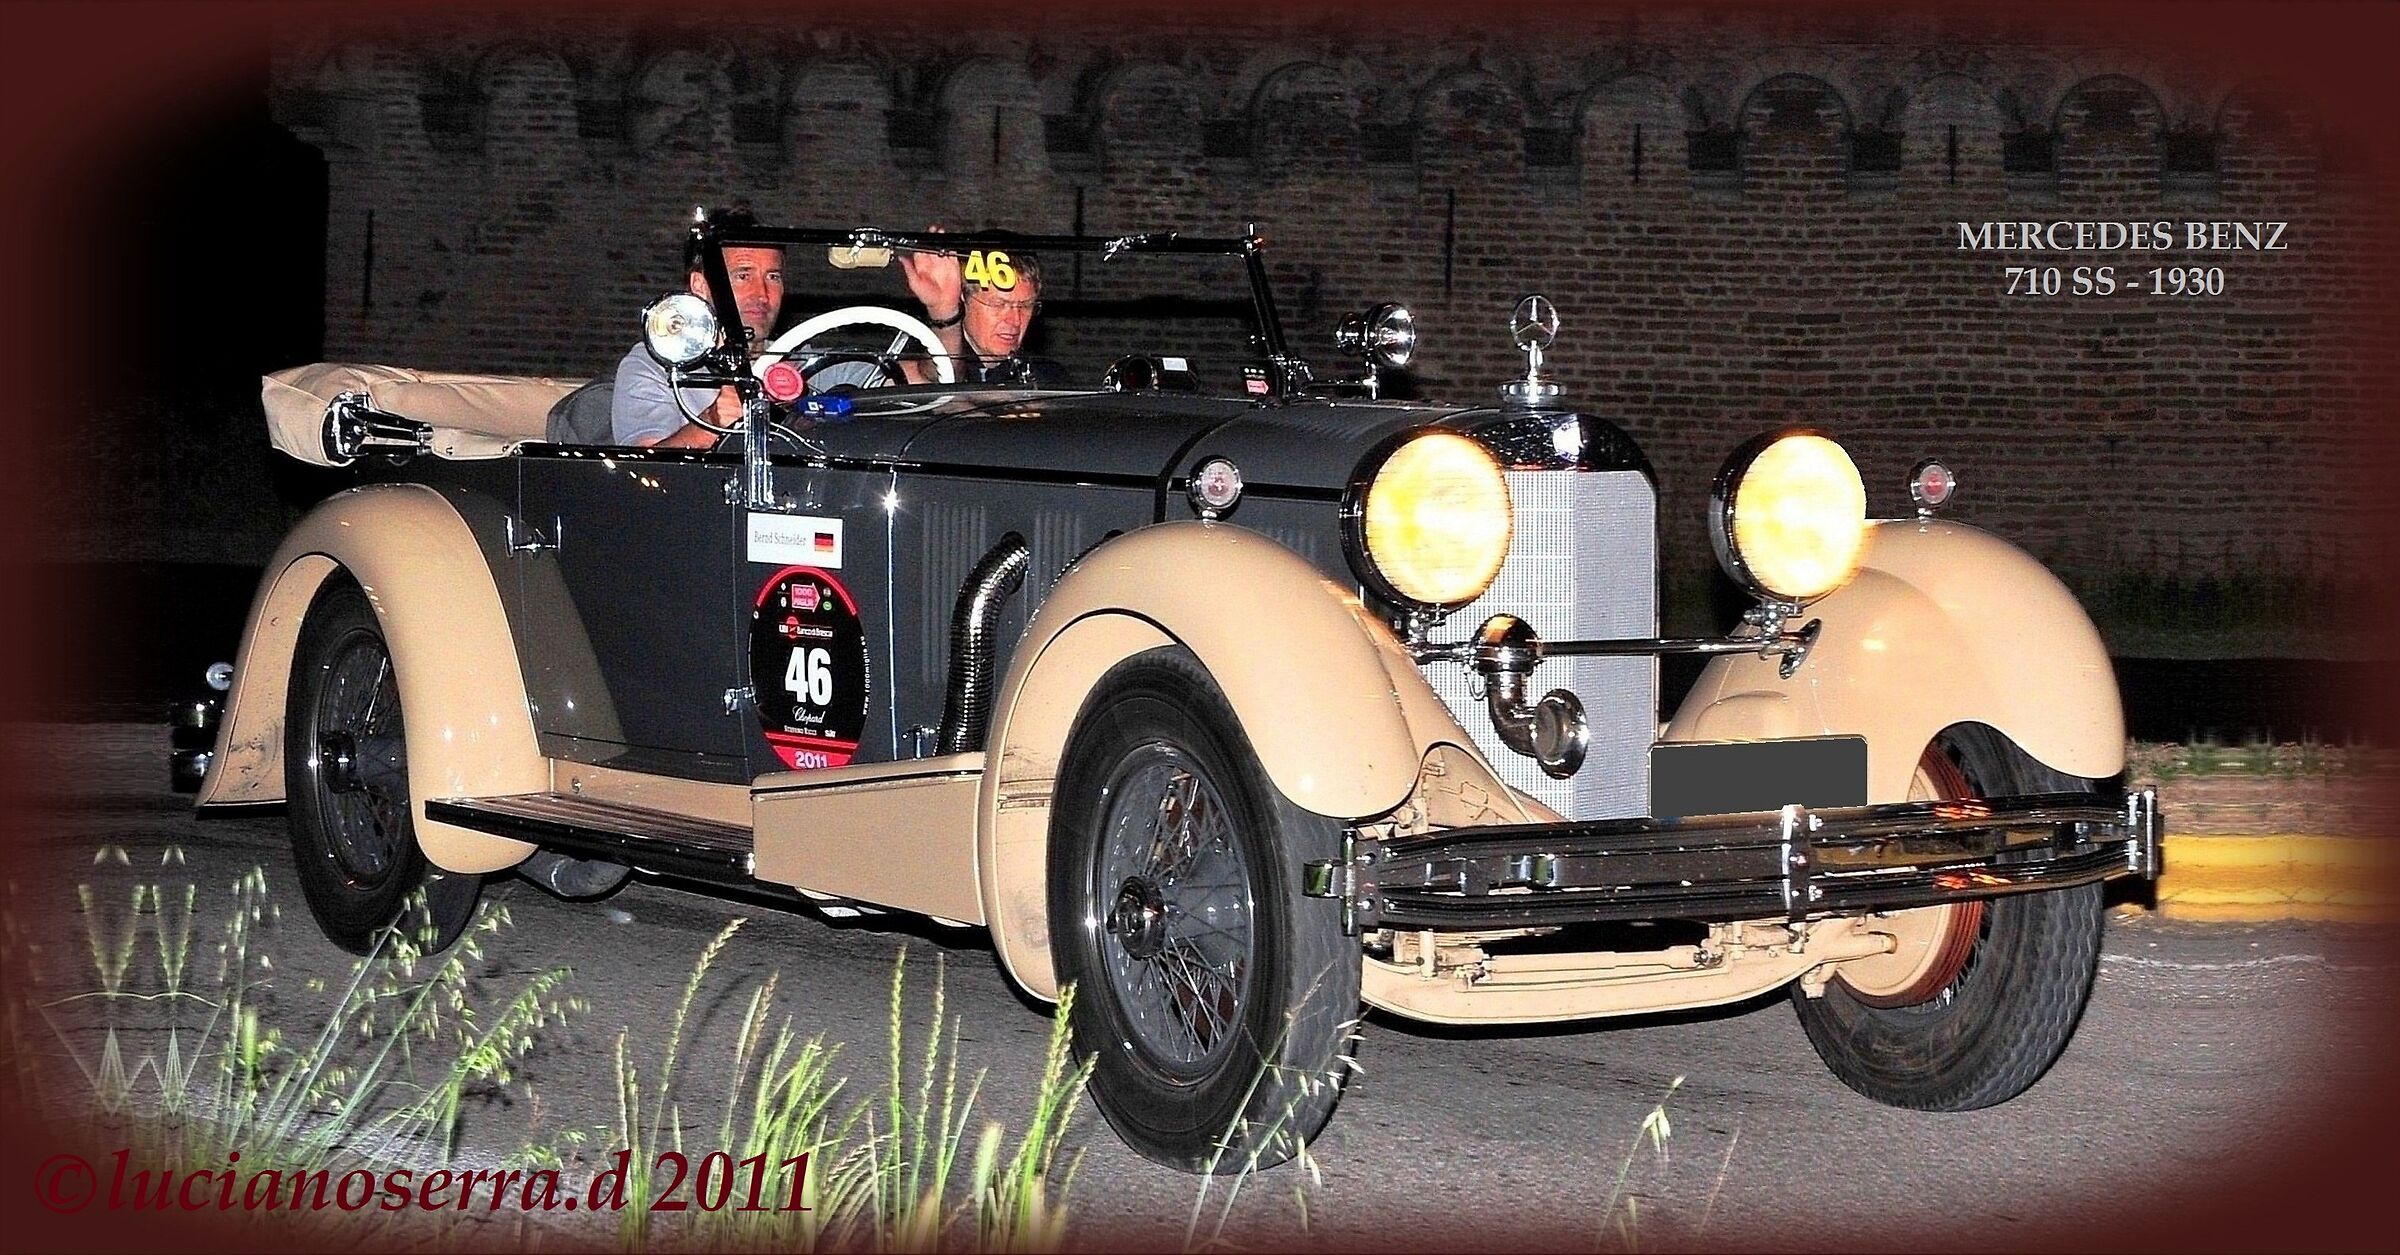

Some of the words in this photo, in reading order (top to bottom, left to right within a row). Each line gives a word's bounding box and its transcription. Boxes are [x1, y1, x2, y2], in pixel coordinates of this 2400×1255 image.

[965, 250, 1016, 289] 46
[754, 530, 773, 544] Bernd
[785, 646, 833, 706] 46
[792, 705, 826, 725] Chopard
[795, 750, 828, 769] 2011
